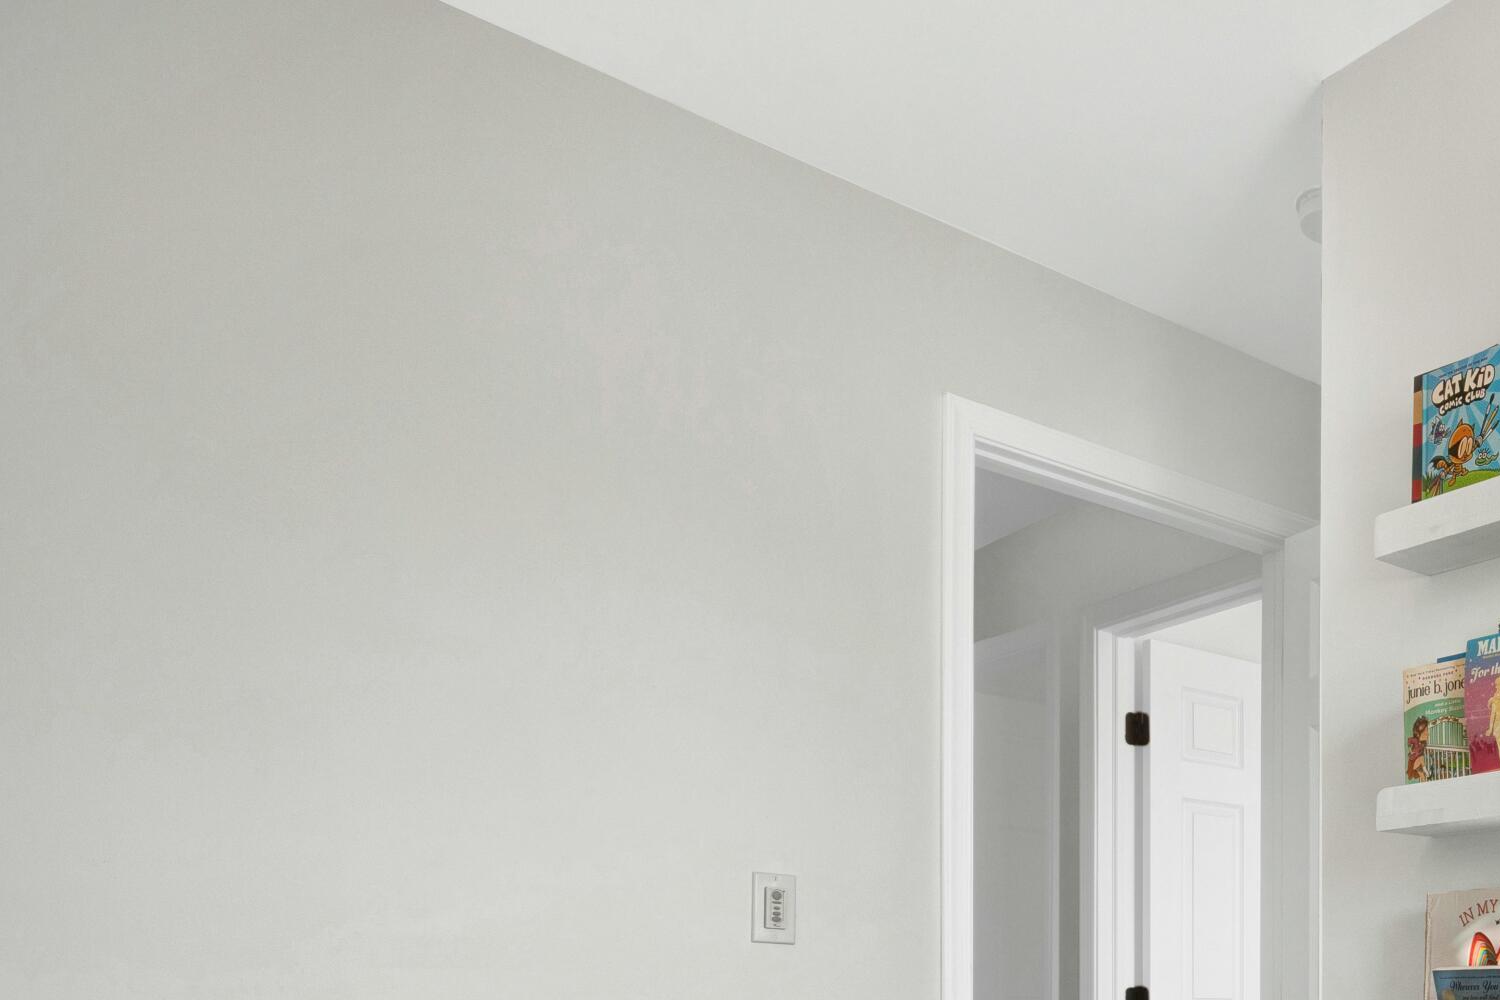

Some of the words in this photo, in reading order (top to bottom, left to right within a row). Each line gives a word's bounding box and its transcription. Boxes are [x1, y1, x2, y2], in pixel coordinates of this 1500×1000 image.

[1431, 373, 1463, 405] CAT
[1470, 665, 1490, 683] For
[1407, 683, 1431, 704] junie
[1433, 679, 1443, 694] b.
[1459, 907, 1475, 927] IN
[1476, 899, 1498, 917] MY
[1482, 981, 1499, 993] You
